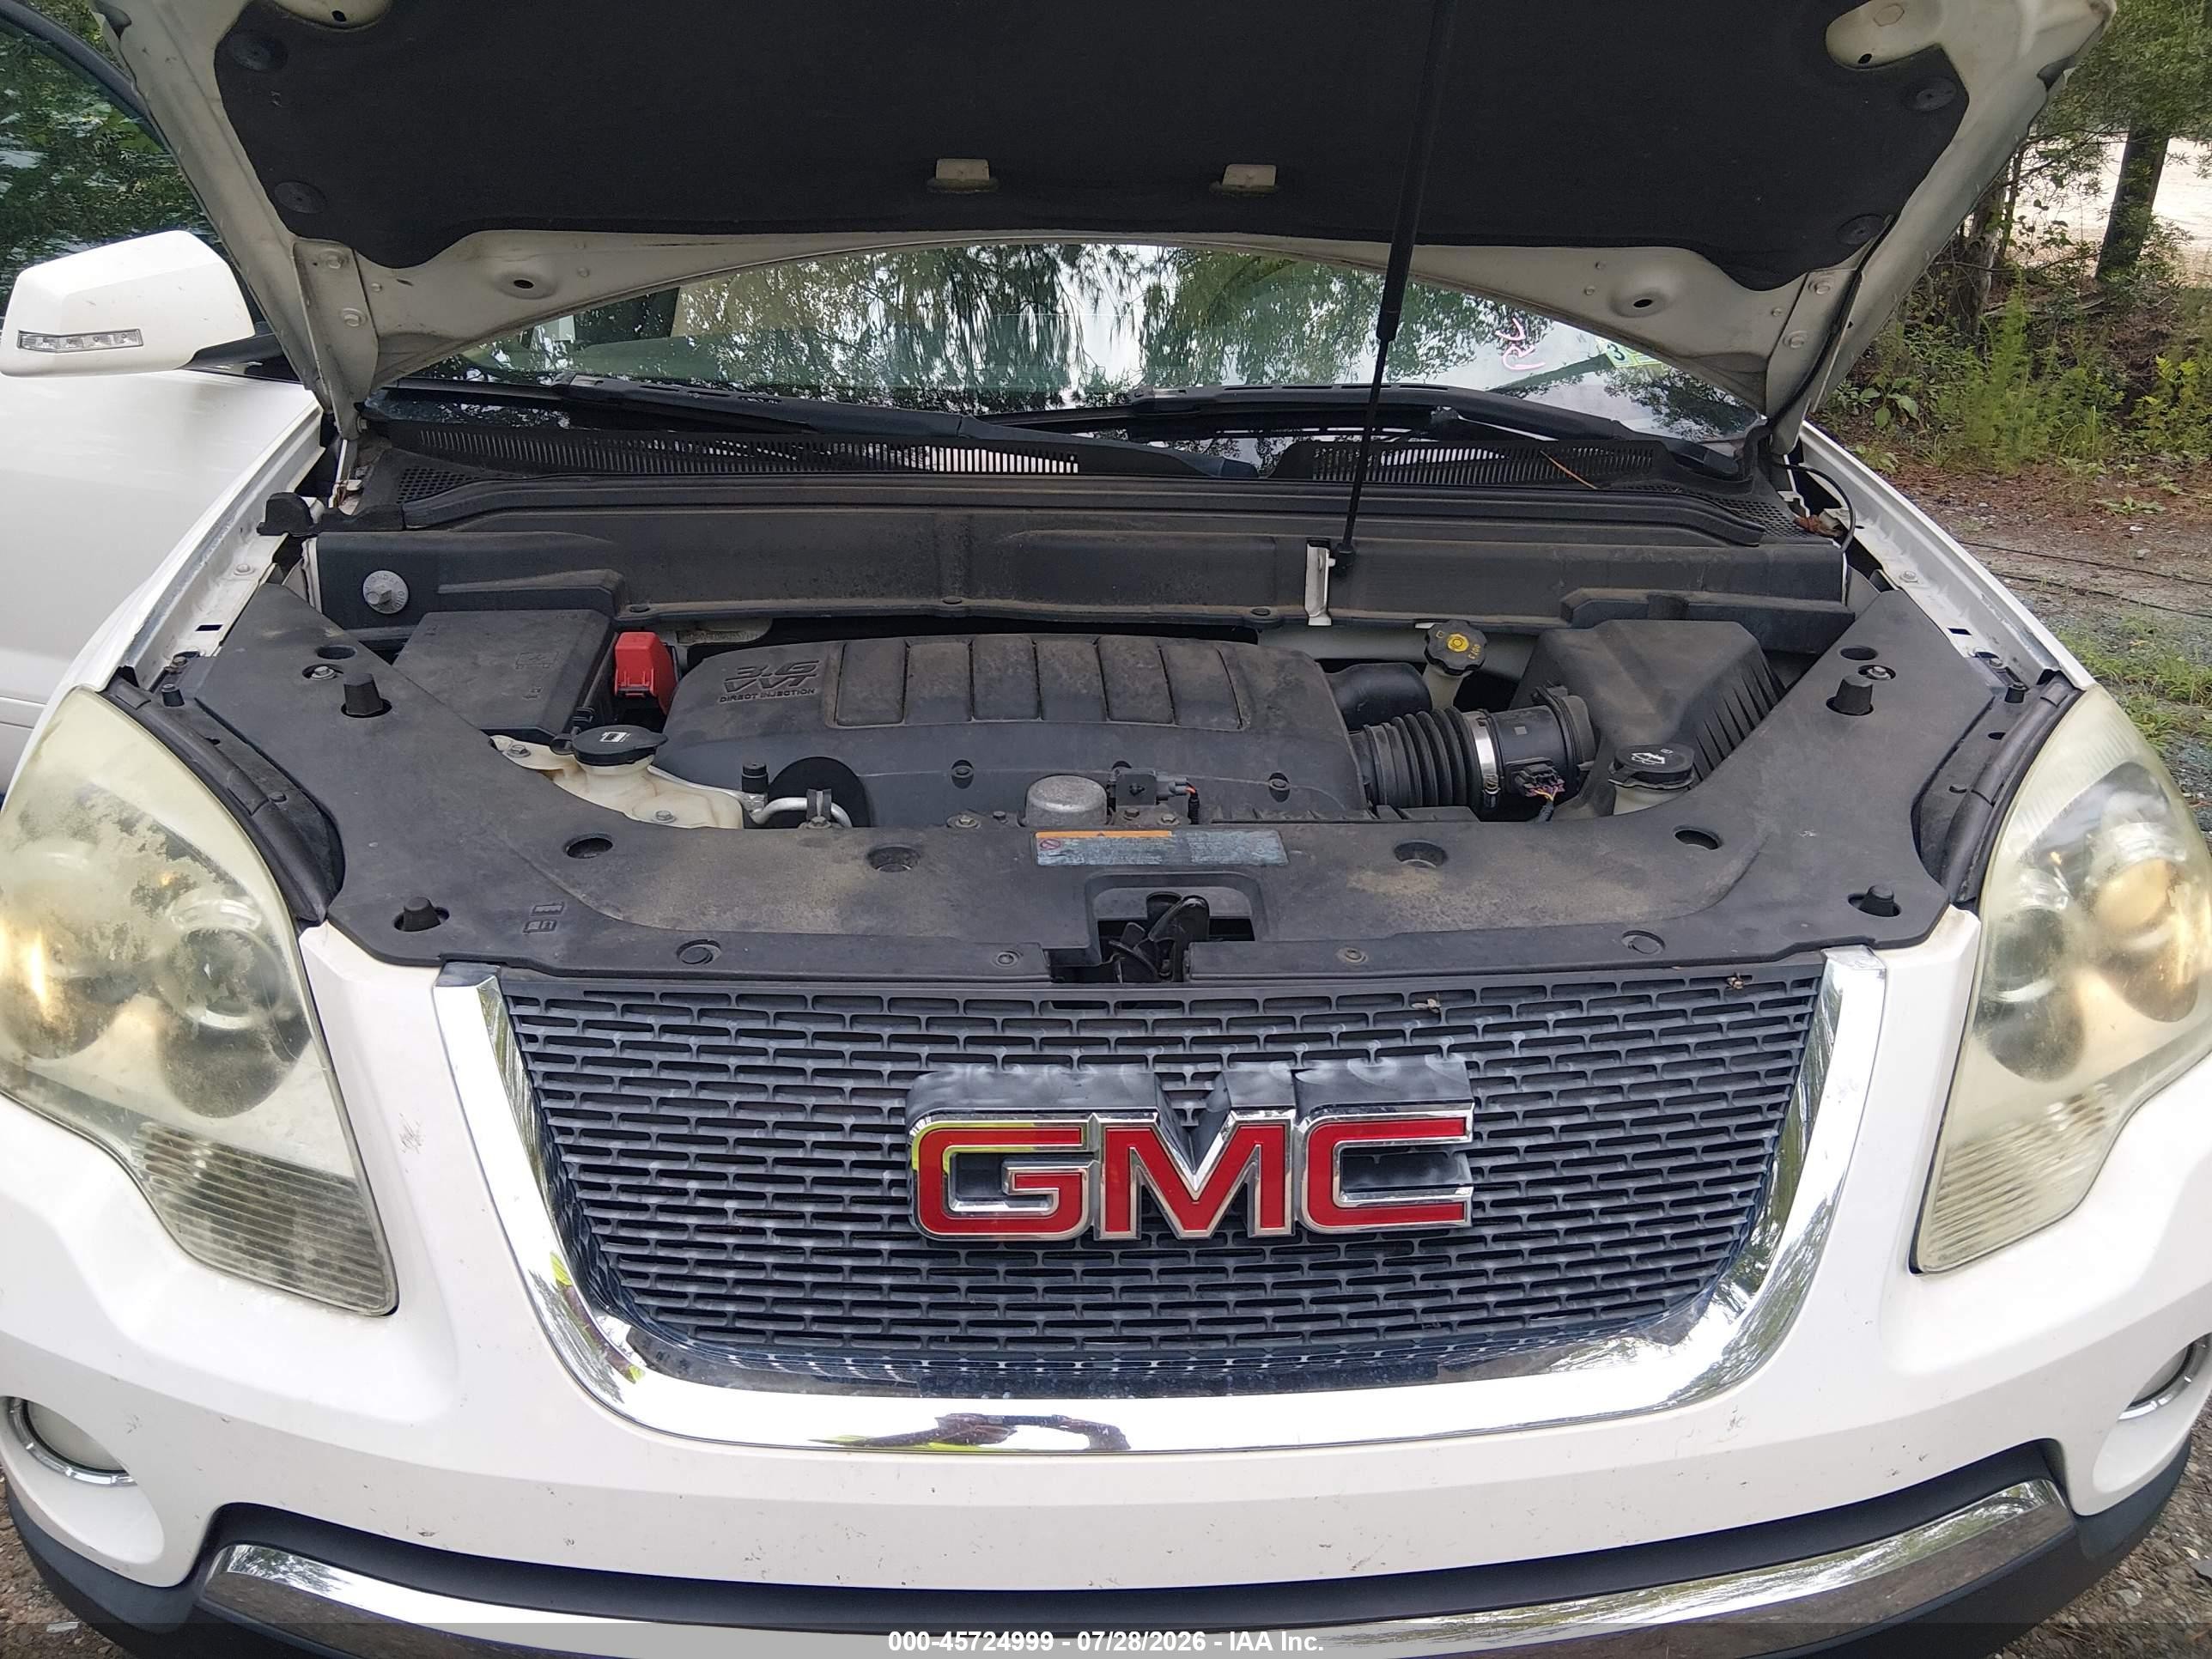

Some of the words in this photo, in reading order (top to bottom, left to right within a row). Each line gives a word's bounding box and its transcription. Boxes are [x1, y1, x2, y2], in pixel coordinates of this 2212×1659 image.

[724, 659, 819, 681] 3.6
[719, 692, 759, 703] DIRECT
[760, 688, 816, 699] INJECTION
[907, 1102, 1474, 1242] GMC
